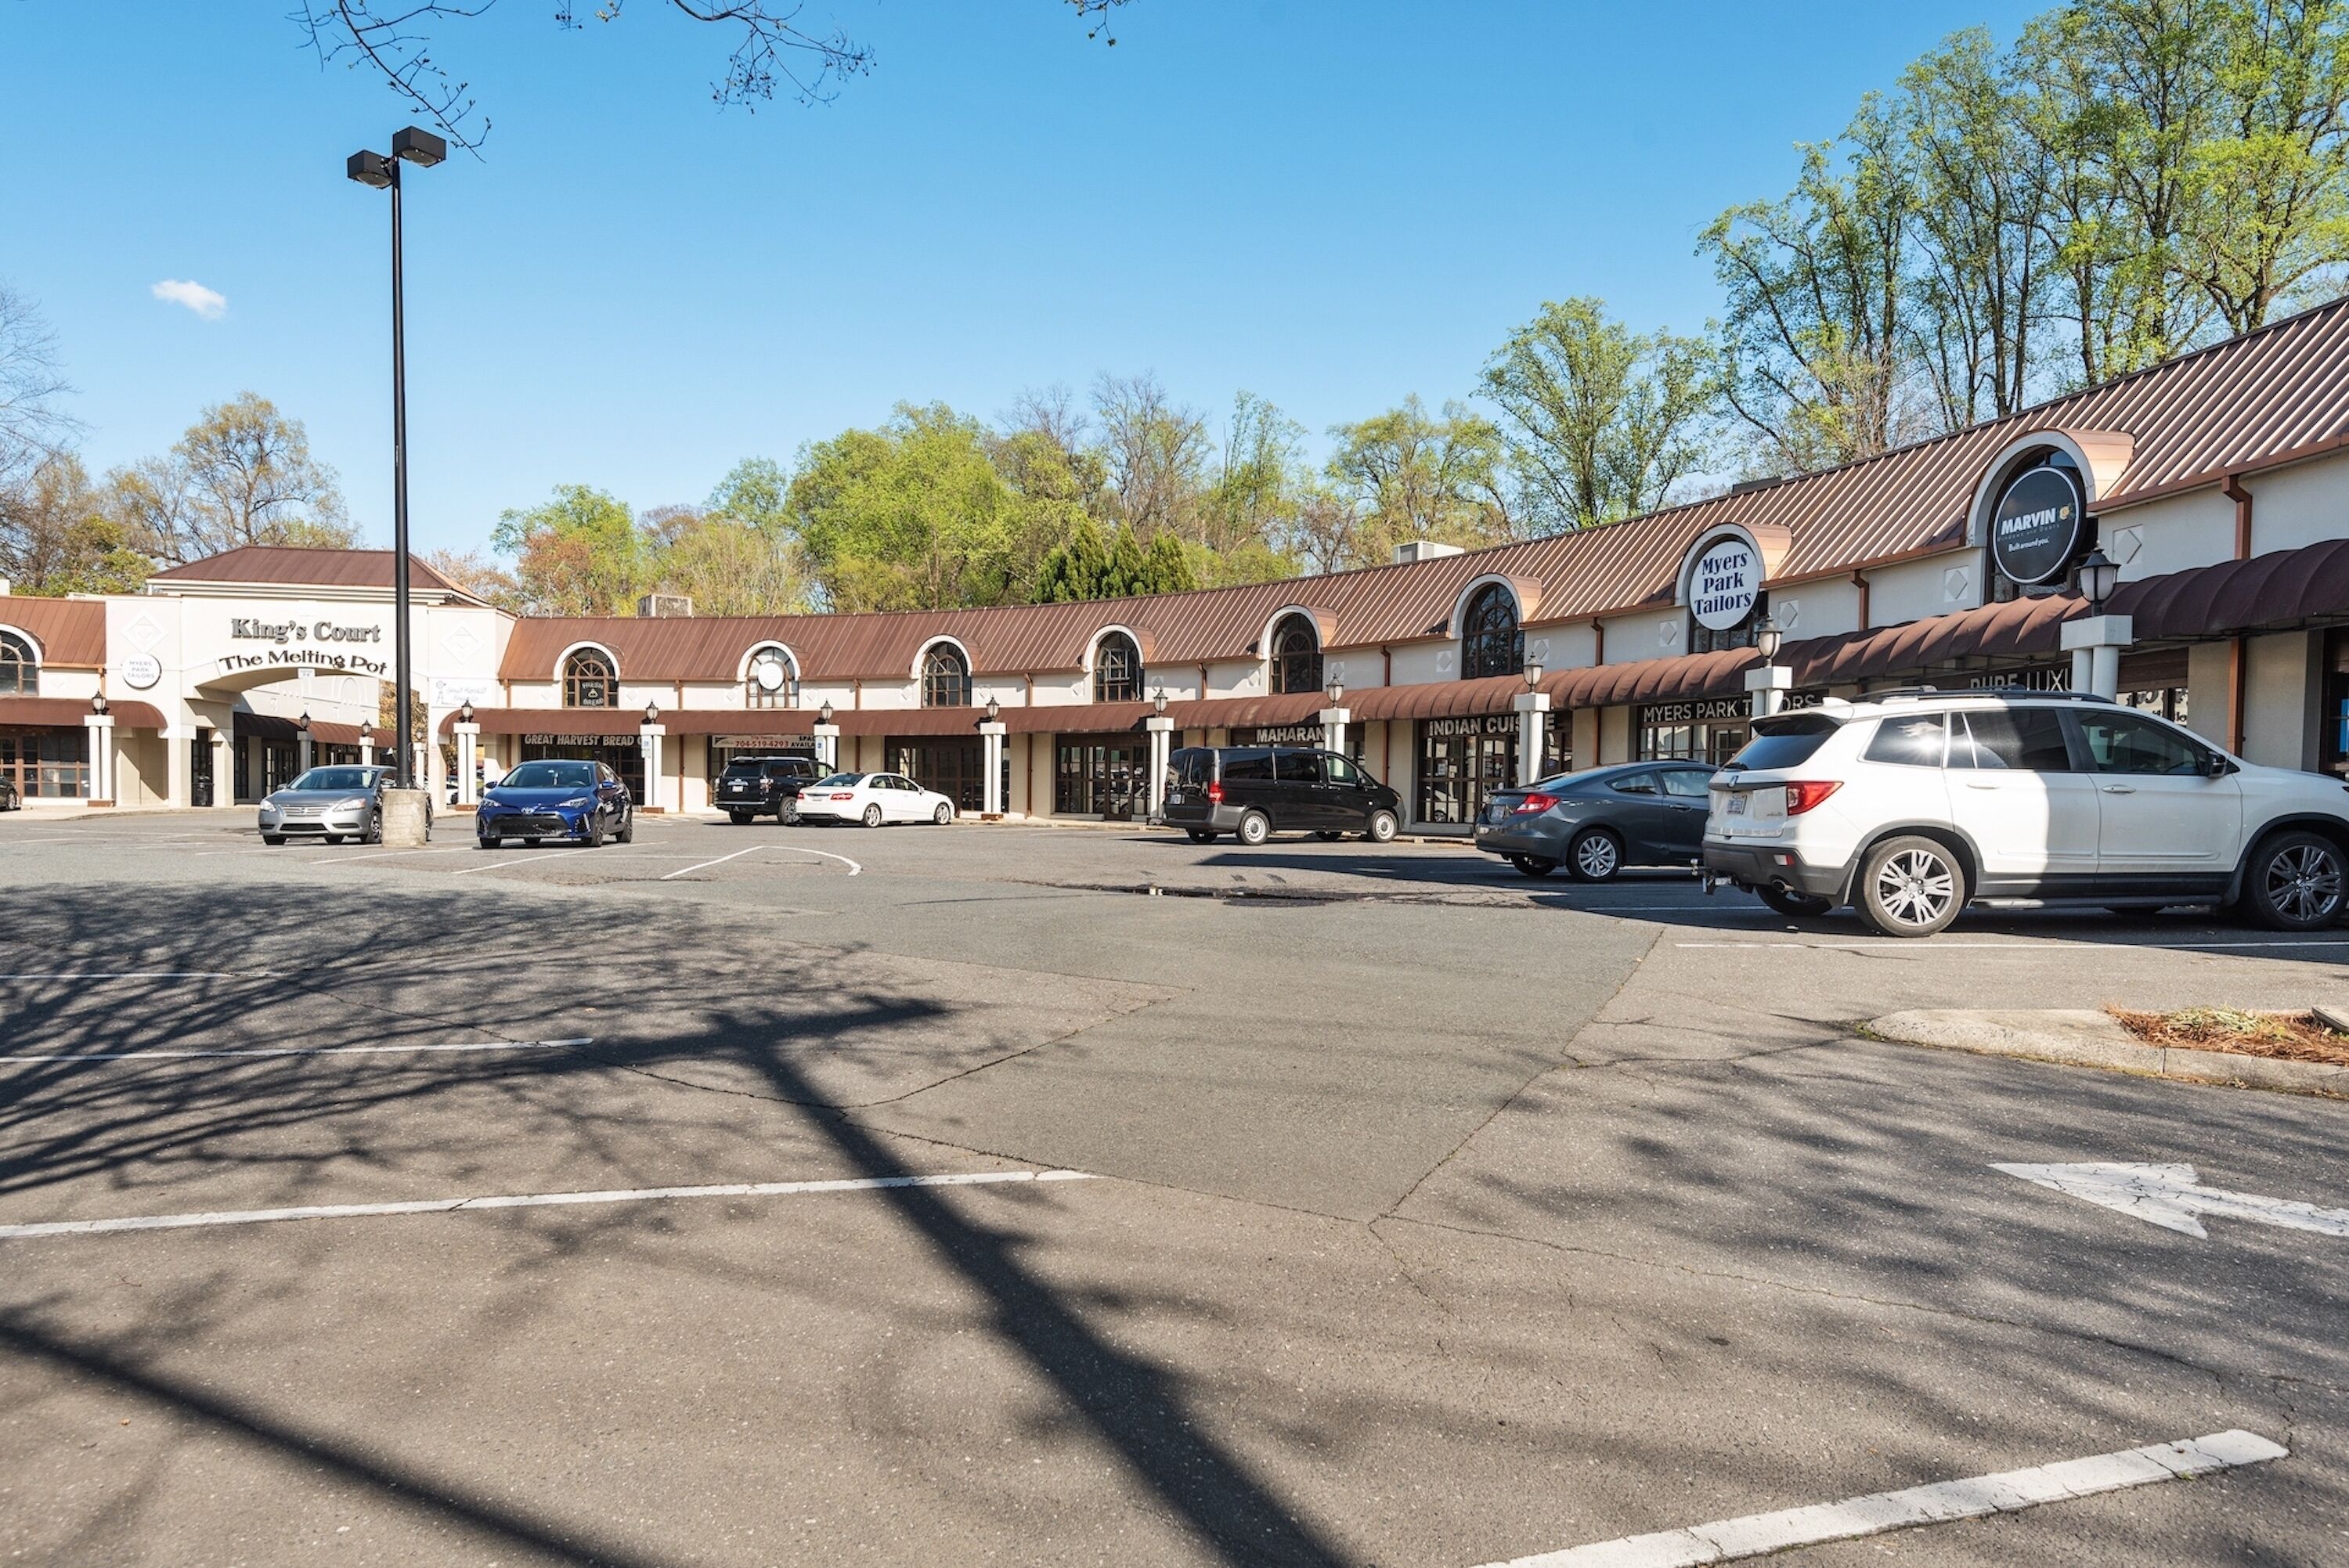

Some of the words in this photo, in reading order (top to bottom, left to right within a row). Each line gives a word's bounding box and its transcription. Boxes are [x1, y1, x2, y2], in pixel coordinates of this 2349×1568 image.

[2001, 506, 2057, 535] MARVIN
[1701, 552, 1748, 575] Myers
[1703, 572, 1745, 594] Park
[1694, 593, 1752, 615] Tailors
[231, 618, 307, 644] King's
[314, 621, 381, 643] Court
[218, 654, 263, 670] The
[268, 650, 346, 670] Melting
[349, 654, 388, 675] Pot
[582, 681, 604, 690] FRESH
[1644, 704, 1692, 723] MYERS
[1696, 700, 1738, 719] PARK
[1742, 694, 1816, 716] TORS
[1257, 726, 1325, 743] MAHARAN
[1429, 717, 1481, 736] INDIAN
[524, 734, 554, 744] GREAT
[557, 734, 600, 746] HARVEST
[602, 735, 634, 746] BREAD
